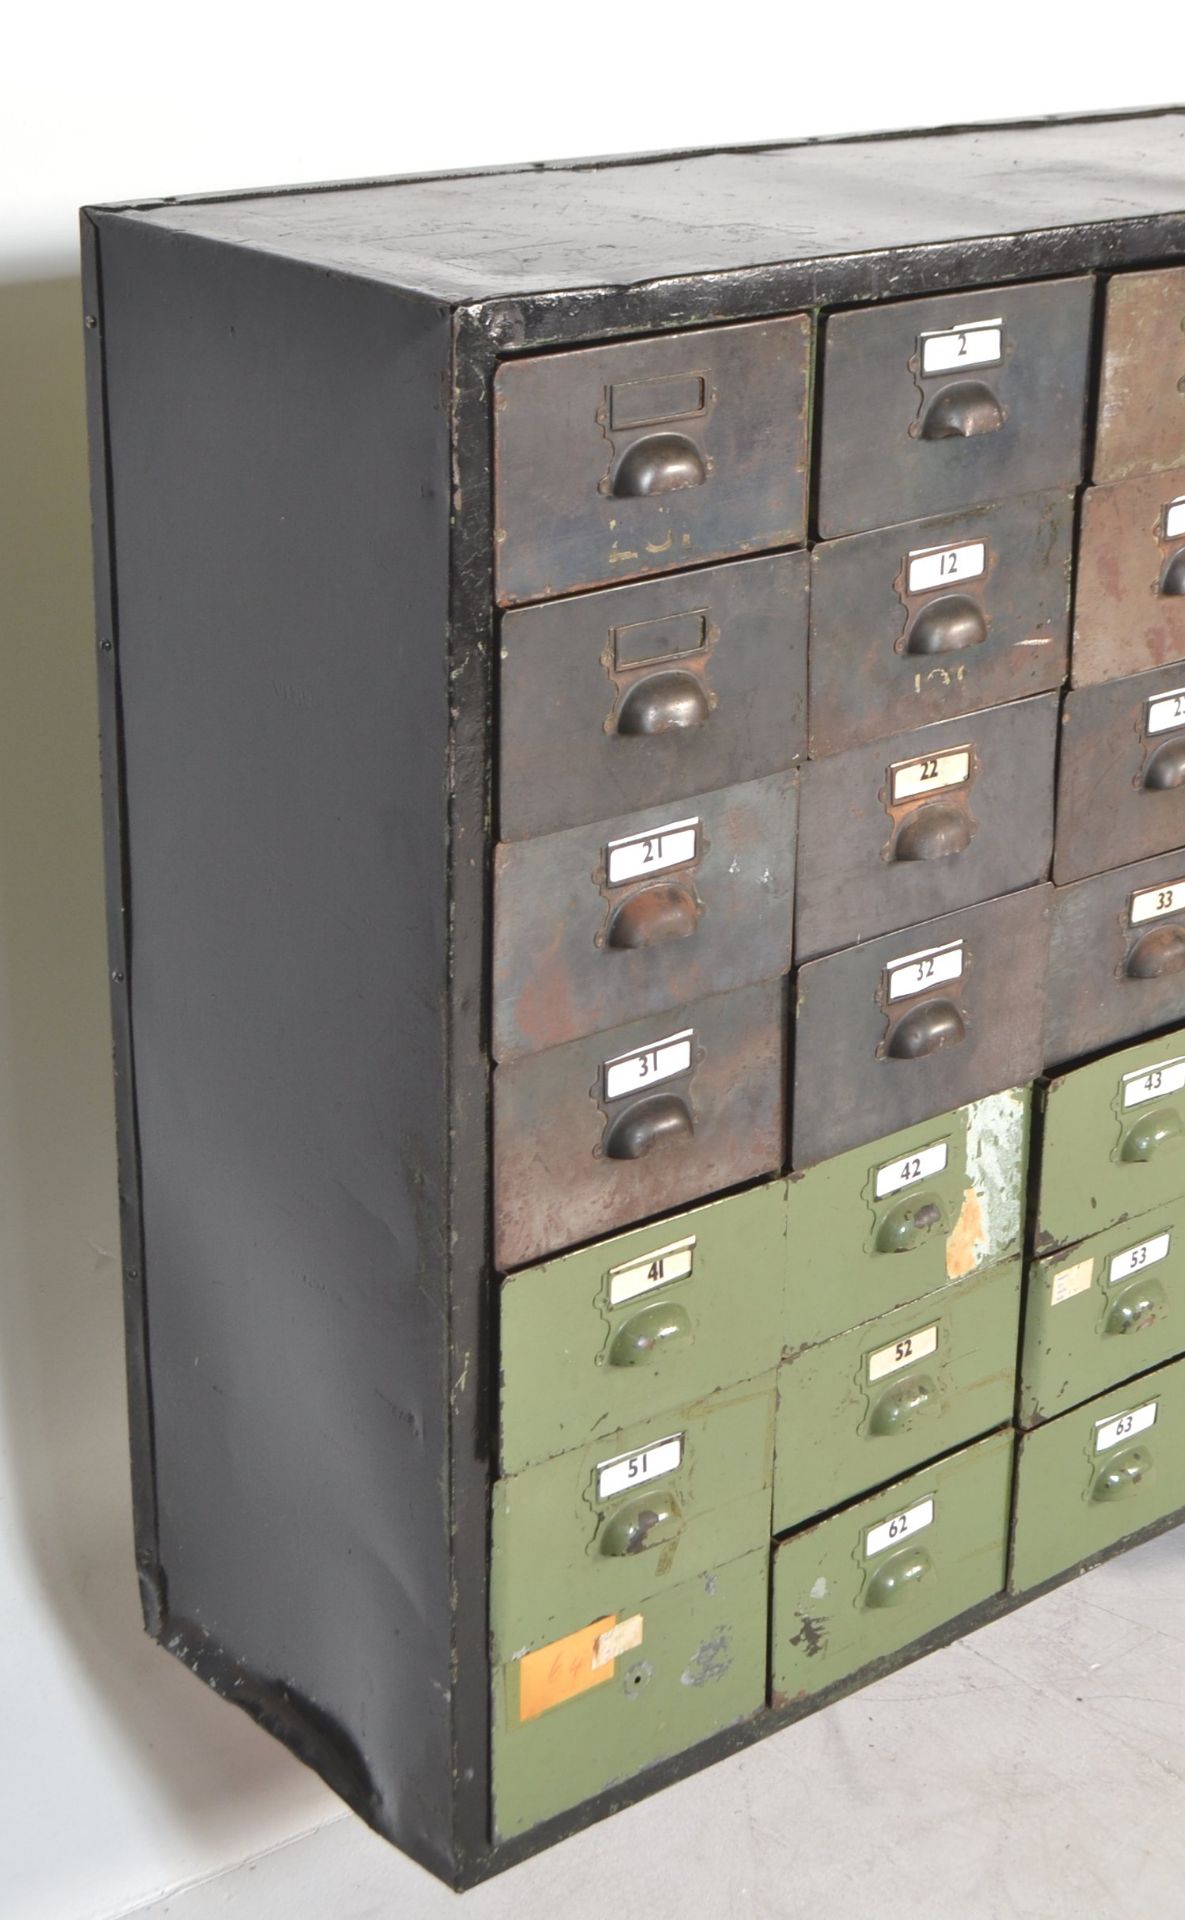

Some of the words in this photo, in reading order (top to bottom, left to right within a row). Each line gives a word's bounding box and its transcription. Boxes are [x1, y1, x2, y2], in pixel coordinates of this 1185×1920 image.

[958, 332, 967, 356] 2
[940, 552, 958, 576] 12
[920, 760, 938, 781] 22
[642, 838, 663, 864] 21
[1156, 890, 1173, 911] 33
[916, 960, 935, 981] 32
[638, 1053, 658, 1077] 31
[1144, 1071, 1162, 1091] 43
[900, 1158, 921, 1180] 42
[1130, 1247, 1147, 1268] 53
[647, 1260, 664, 1282] 41
[895, 1339, 912, 1361] 52
[1116, 1416, 1133, 1436] 63
[628, 1454, 647, 1477] 51
[889, 1516, 908, 1538] 62
